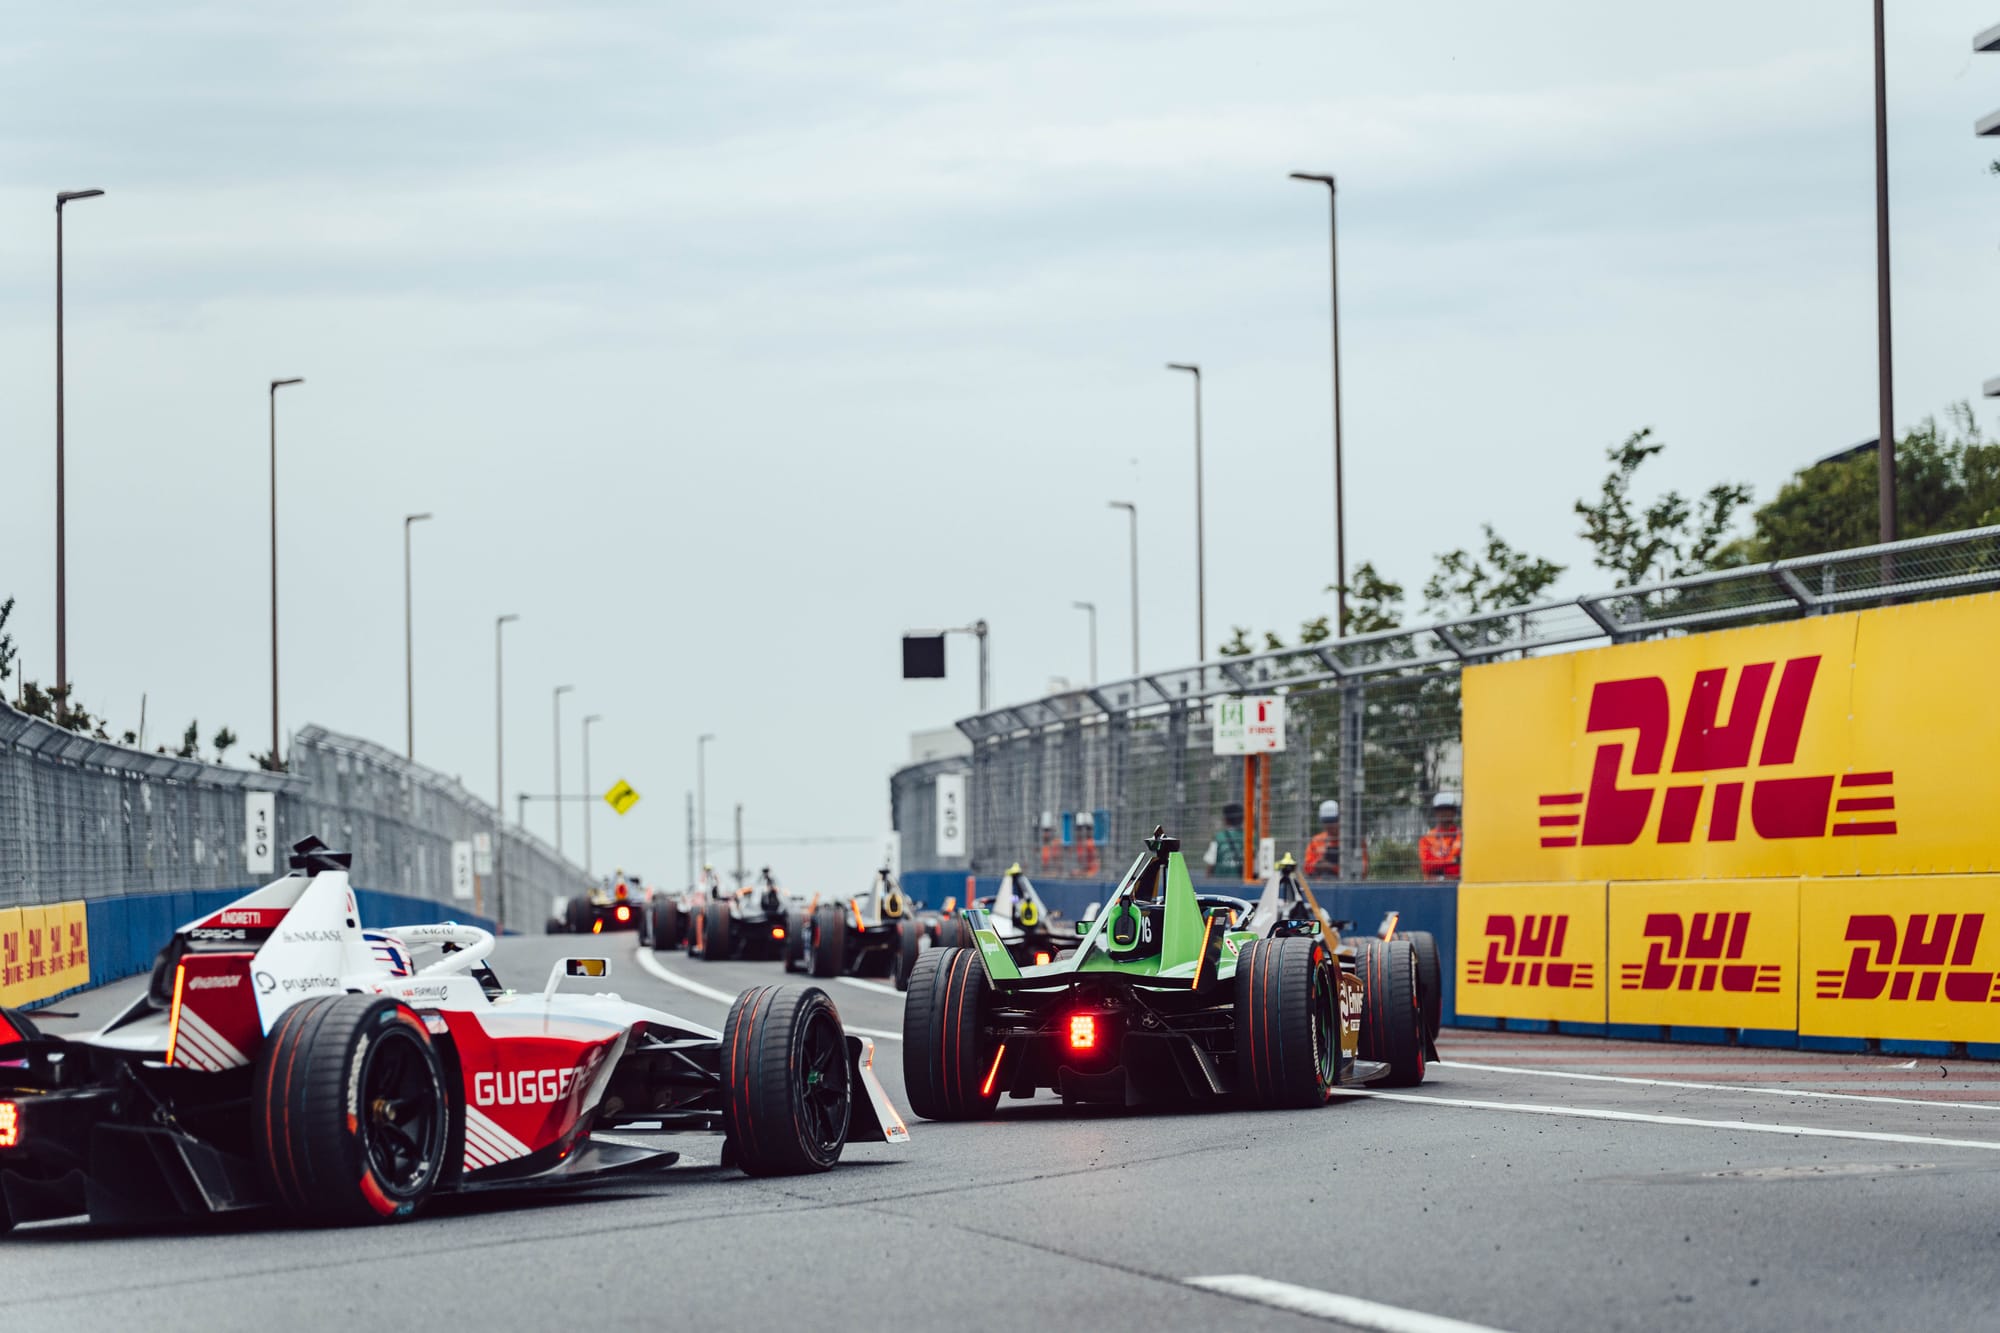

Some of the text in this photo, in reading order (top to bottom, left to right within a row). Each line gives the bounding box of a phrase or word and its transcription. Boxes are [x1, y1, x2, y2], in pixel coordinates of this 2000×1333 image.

[1581, 655, 1835, 847] DHL
[256, 809, 268, 856] 150
[191, 929, 246, 940] PORSCHE
[220, 911, 261, 924] ANDRETTI
[1141, 915, 1152, 943] 16
[1483, 915, 1574, 988] DHL
[1641, 912, 1758, 992] DHL
[1842, 914, 1994, 1002] DHL
